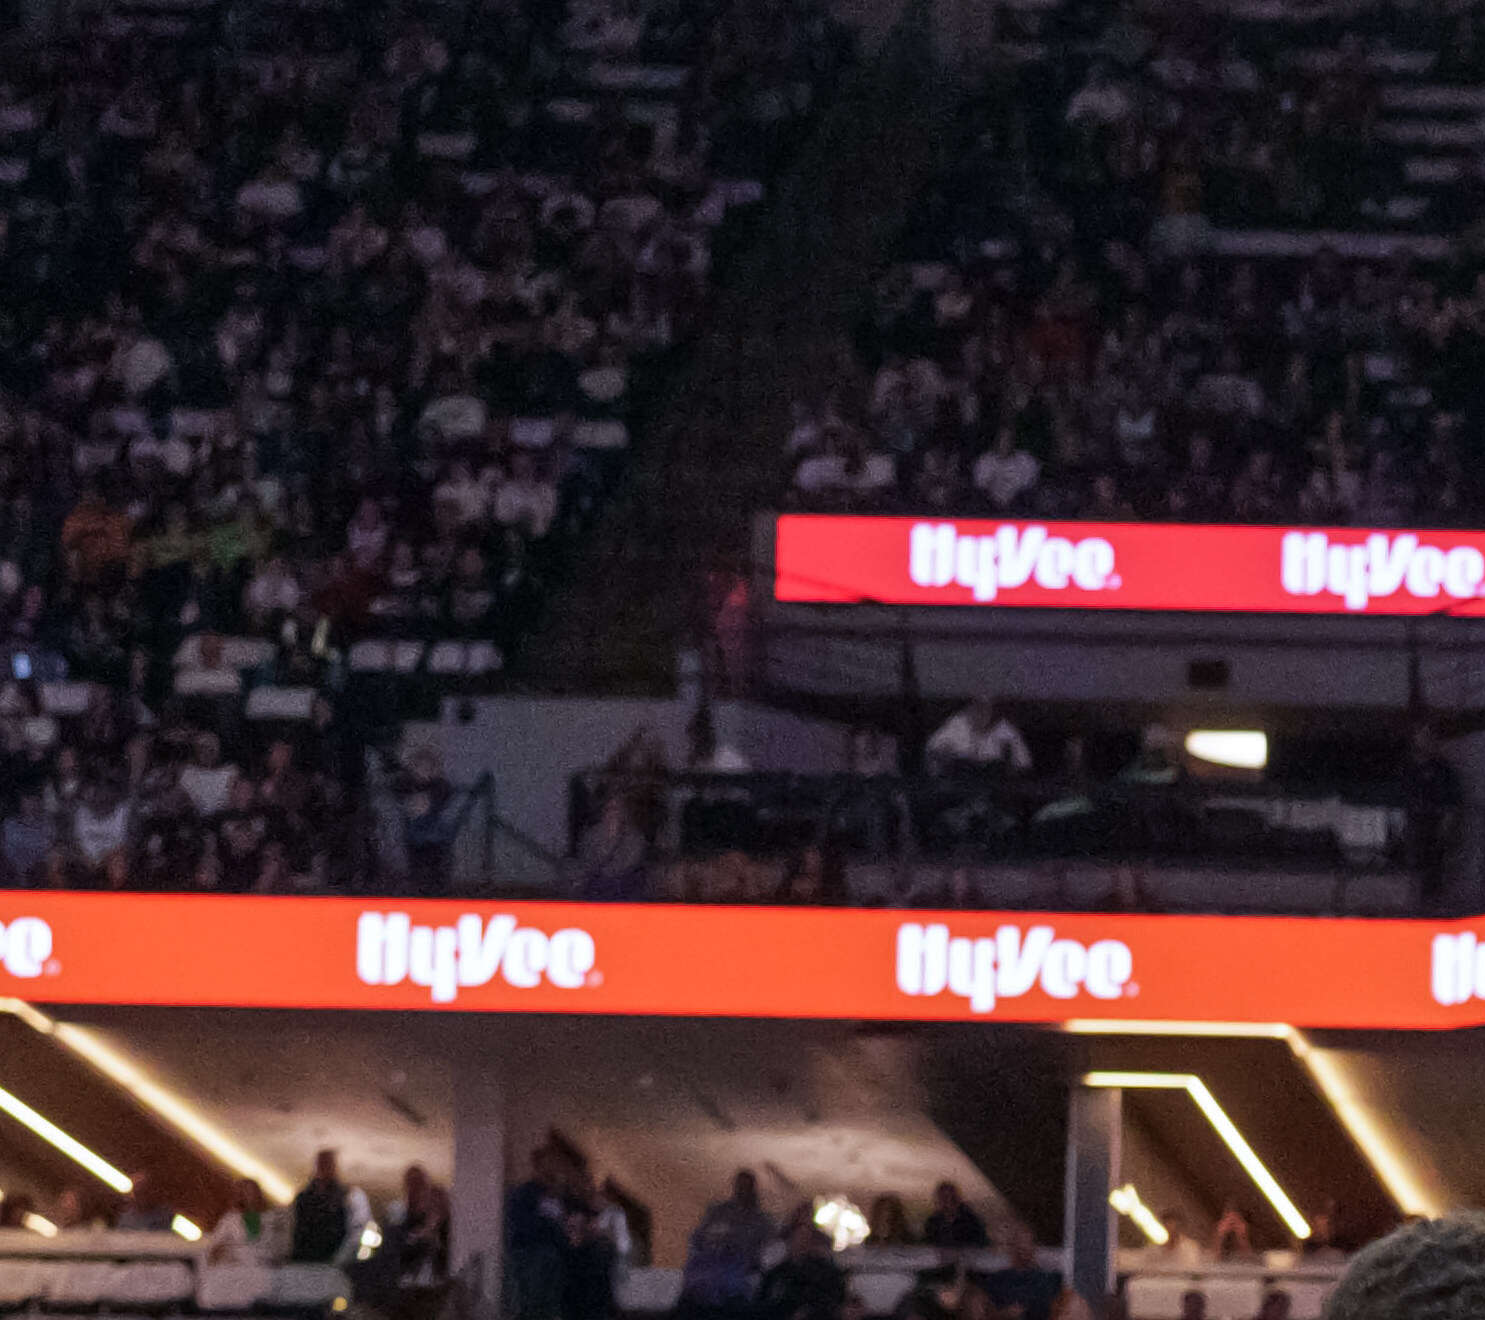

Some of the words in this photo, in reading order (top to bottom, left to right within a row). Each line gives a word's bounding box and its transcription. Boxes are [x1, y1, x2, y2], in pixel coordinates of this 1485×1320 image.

[910, 523, 1115, 602] HyVee
[1281, 532, 1485, 610] HyVee
[356, 911, 595, 1003] HyVee
[896, 923, 1133, 1013] HyVee
